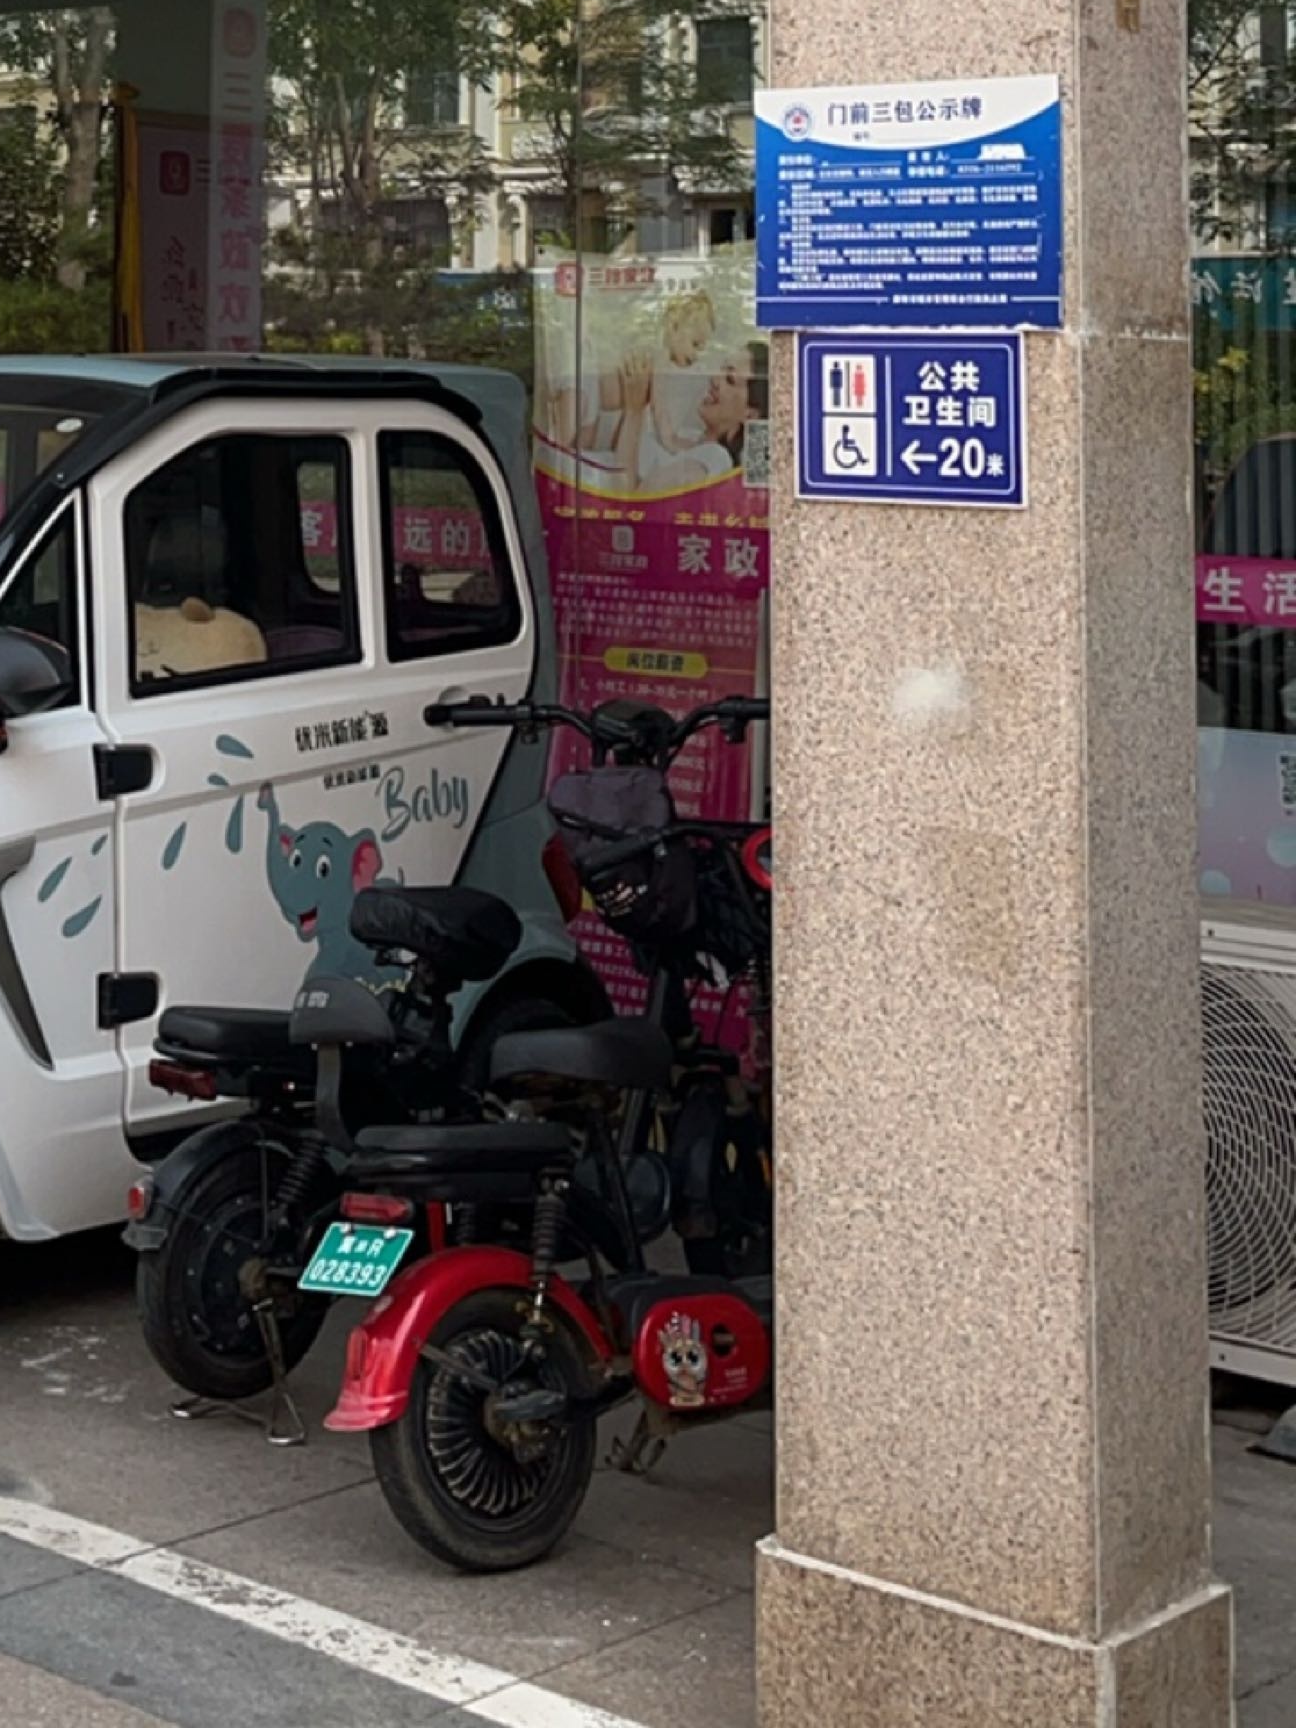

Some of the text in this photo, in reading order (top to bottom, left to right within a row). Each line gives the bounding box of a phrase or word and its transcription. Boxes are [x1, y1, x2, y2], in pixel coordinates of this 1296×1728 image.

[827, 95, 982, 127] 门前三包公示牌
[918, 361, 980, 393] 公共
[903, 396, 996, 429] 卫生间
[939, 437, 1005, 478] 20米
[678, 533, 759, 577] 家政
[375, 765, 470, 842] Baby
